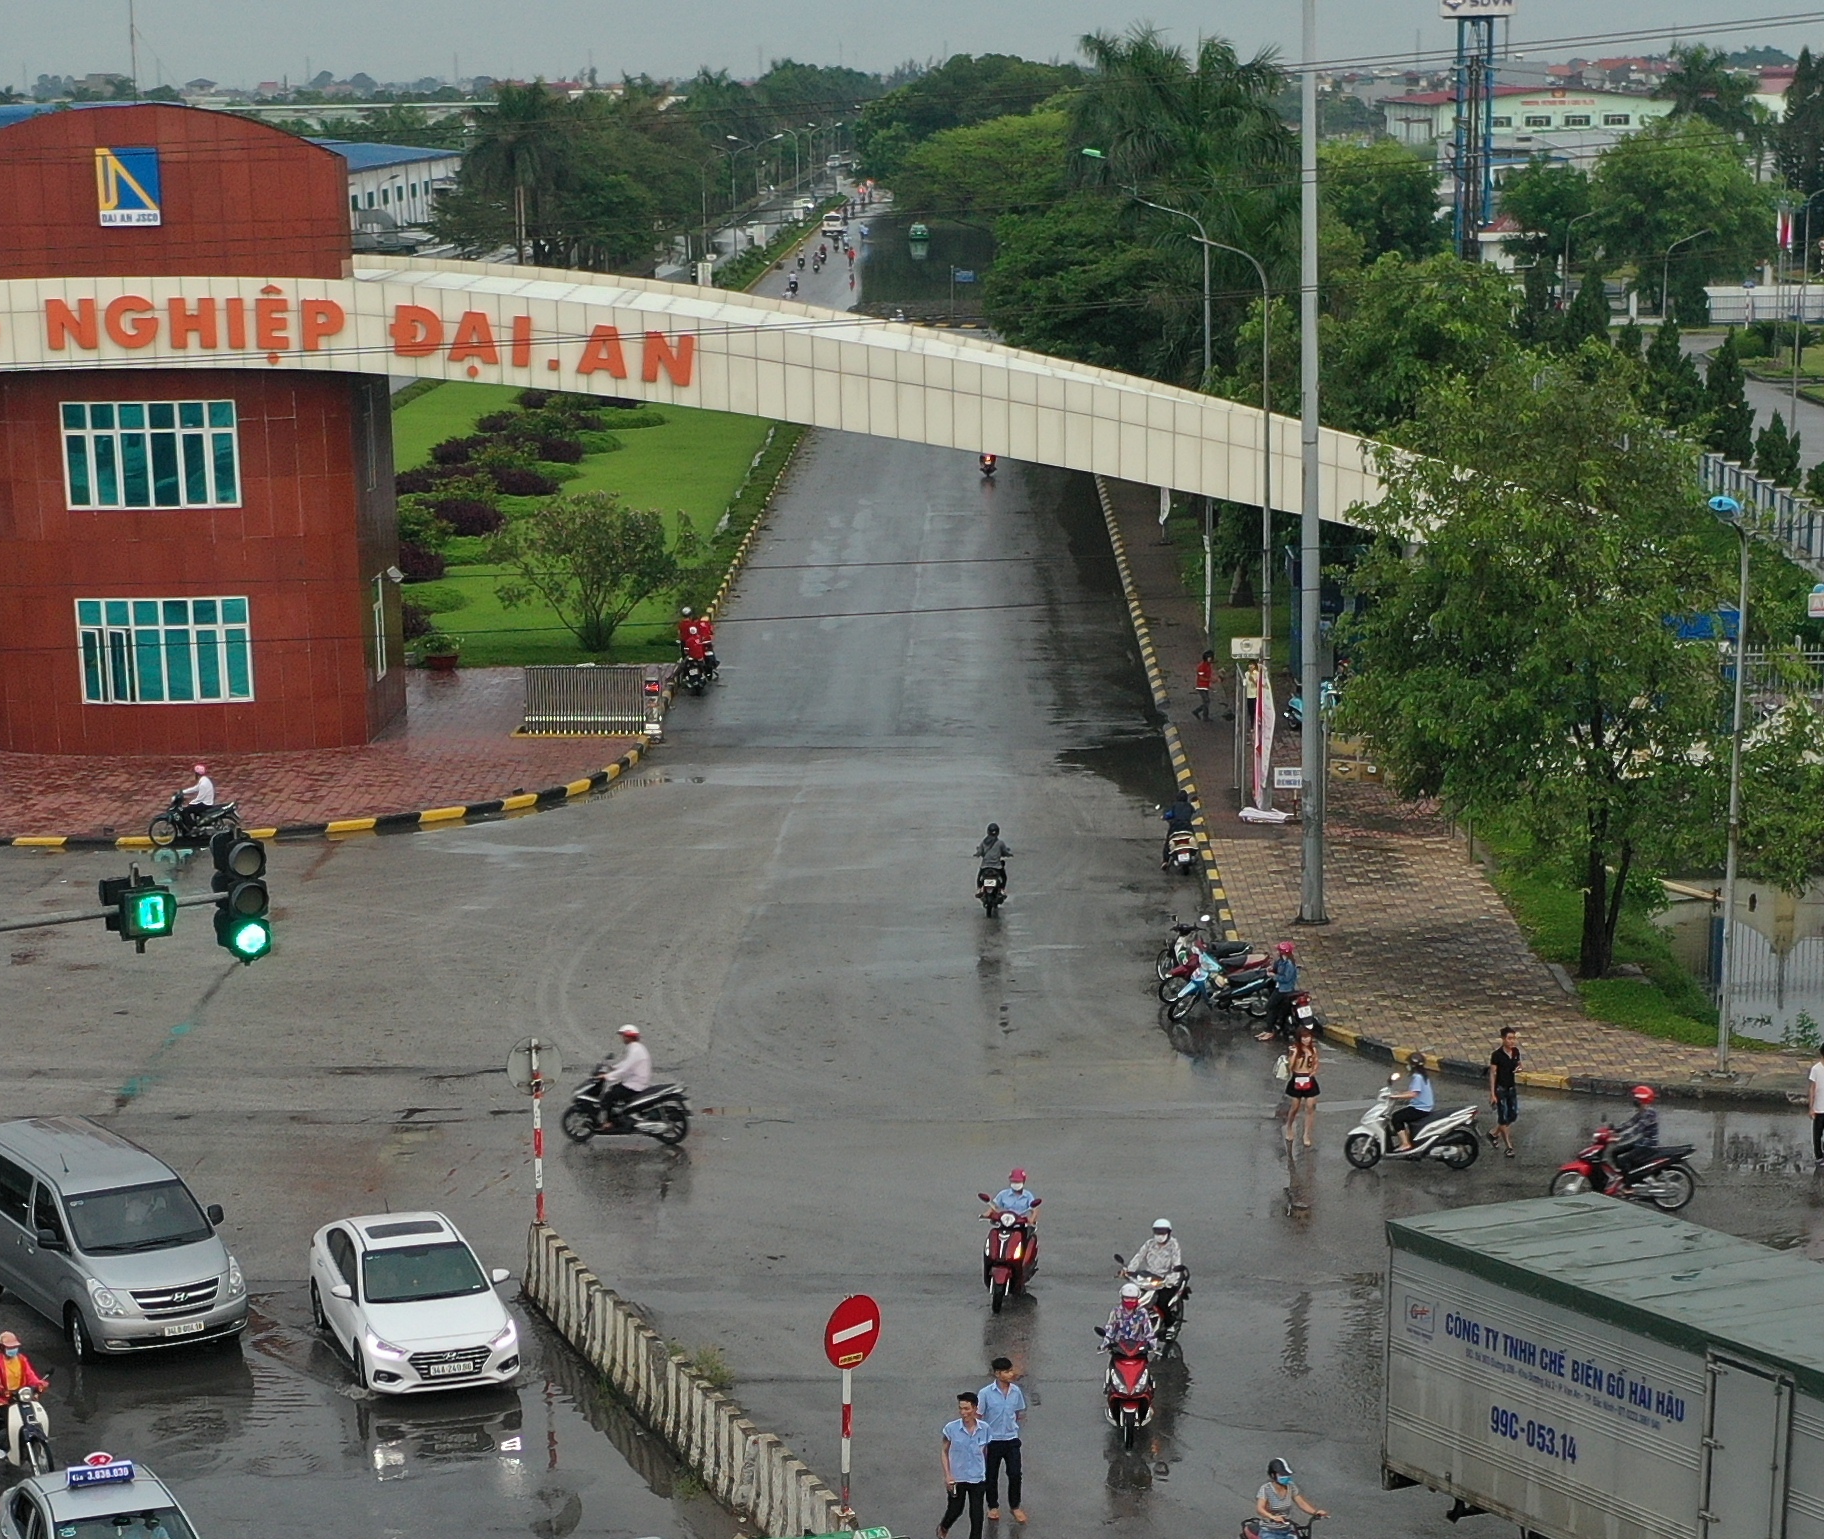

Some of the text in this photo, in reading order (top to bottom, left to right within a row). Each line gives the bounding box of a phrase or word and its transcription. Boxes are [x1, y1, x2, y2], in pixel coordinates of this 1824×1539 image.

[44, 284, 346, 366] NGHIỆP
[1445, 1310, 1480, 1347] CÔNG
[1484, 1326, 1500, 1353] TY
[1502, 1333, 1538, 1368] TNHH
[1539, 1348, 1568, 1378] CHẾ
[1571, 1358, 1604, 1393] BIẾN
[1606, 1368, 1628, 1401] GỖ
[1629, 1376, 1653, 1411] HẢI
[1655, 1389, 1686, 1424] HẬU
[1490, 1405, 1578, 1465] 99C-053.14
